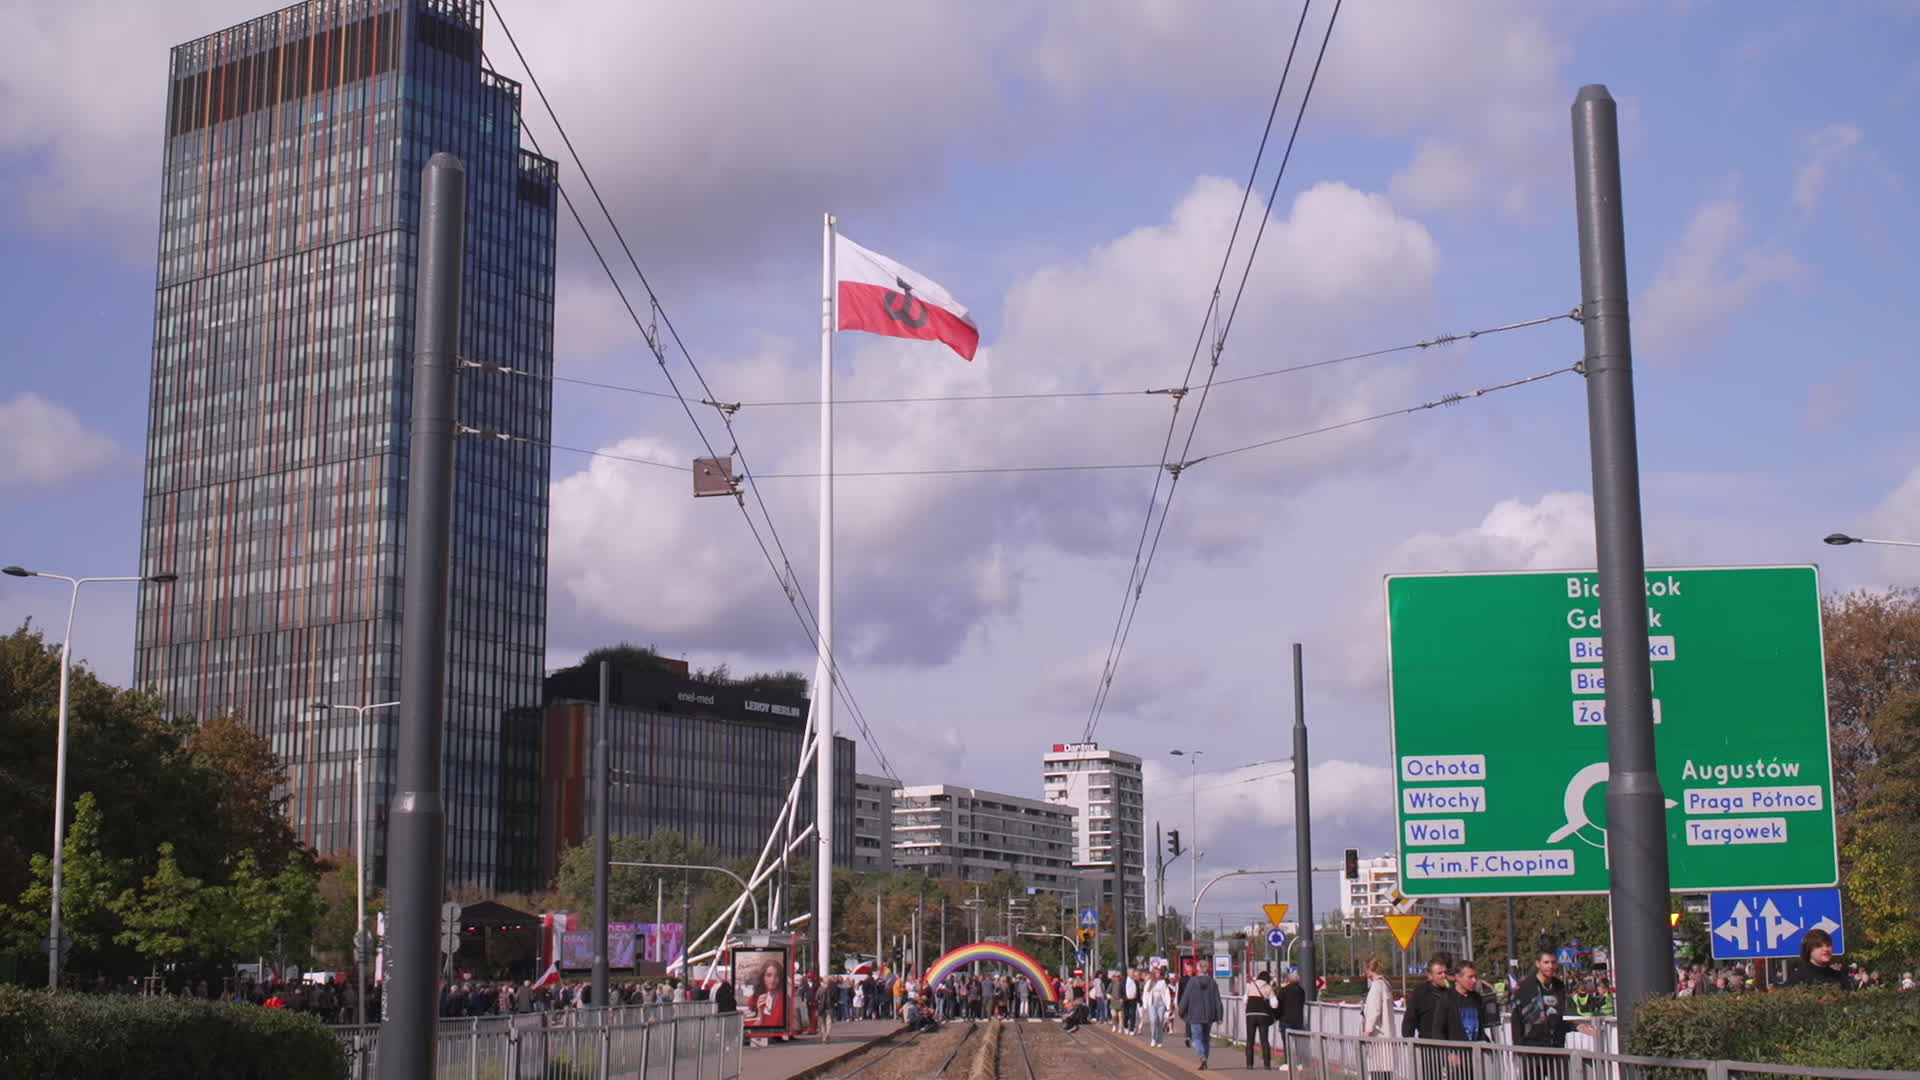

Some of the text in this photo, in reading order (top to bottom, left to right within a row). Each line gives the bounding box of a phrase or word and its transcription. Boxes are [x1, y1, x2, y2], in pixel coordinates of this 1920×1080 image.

[1567, 575, 1681, 598] Biatok
[1567, 607, 1662, 630] Gdk
[677, 691, 715, 705] enel-med
[744, 700, 770, 713] LEROY
[1407, 760, 1480, 776] Ochota
[1682, 756, 1800, 786] Augustów
[1409, 792, 1480, 812] Włochy
[1690, 791, 1817, 813] Praga Północ
[1410, 824, 1459, 840] Wola
[1690, 822, 1782, 844] Targówek
